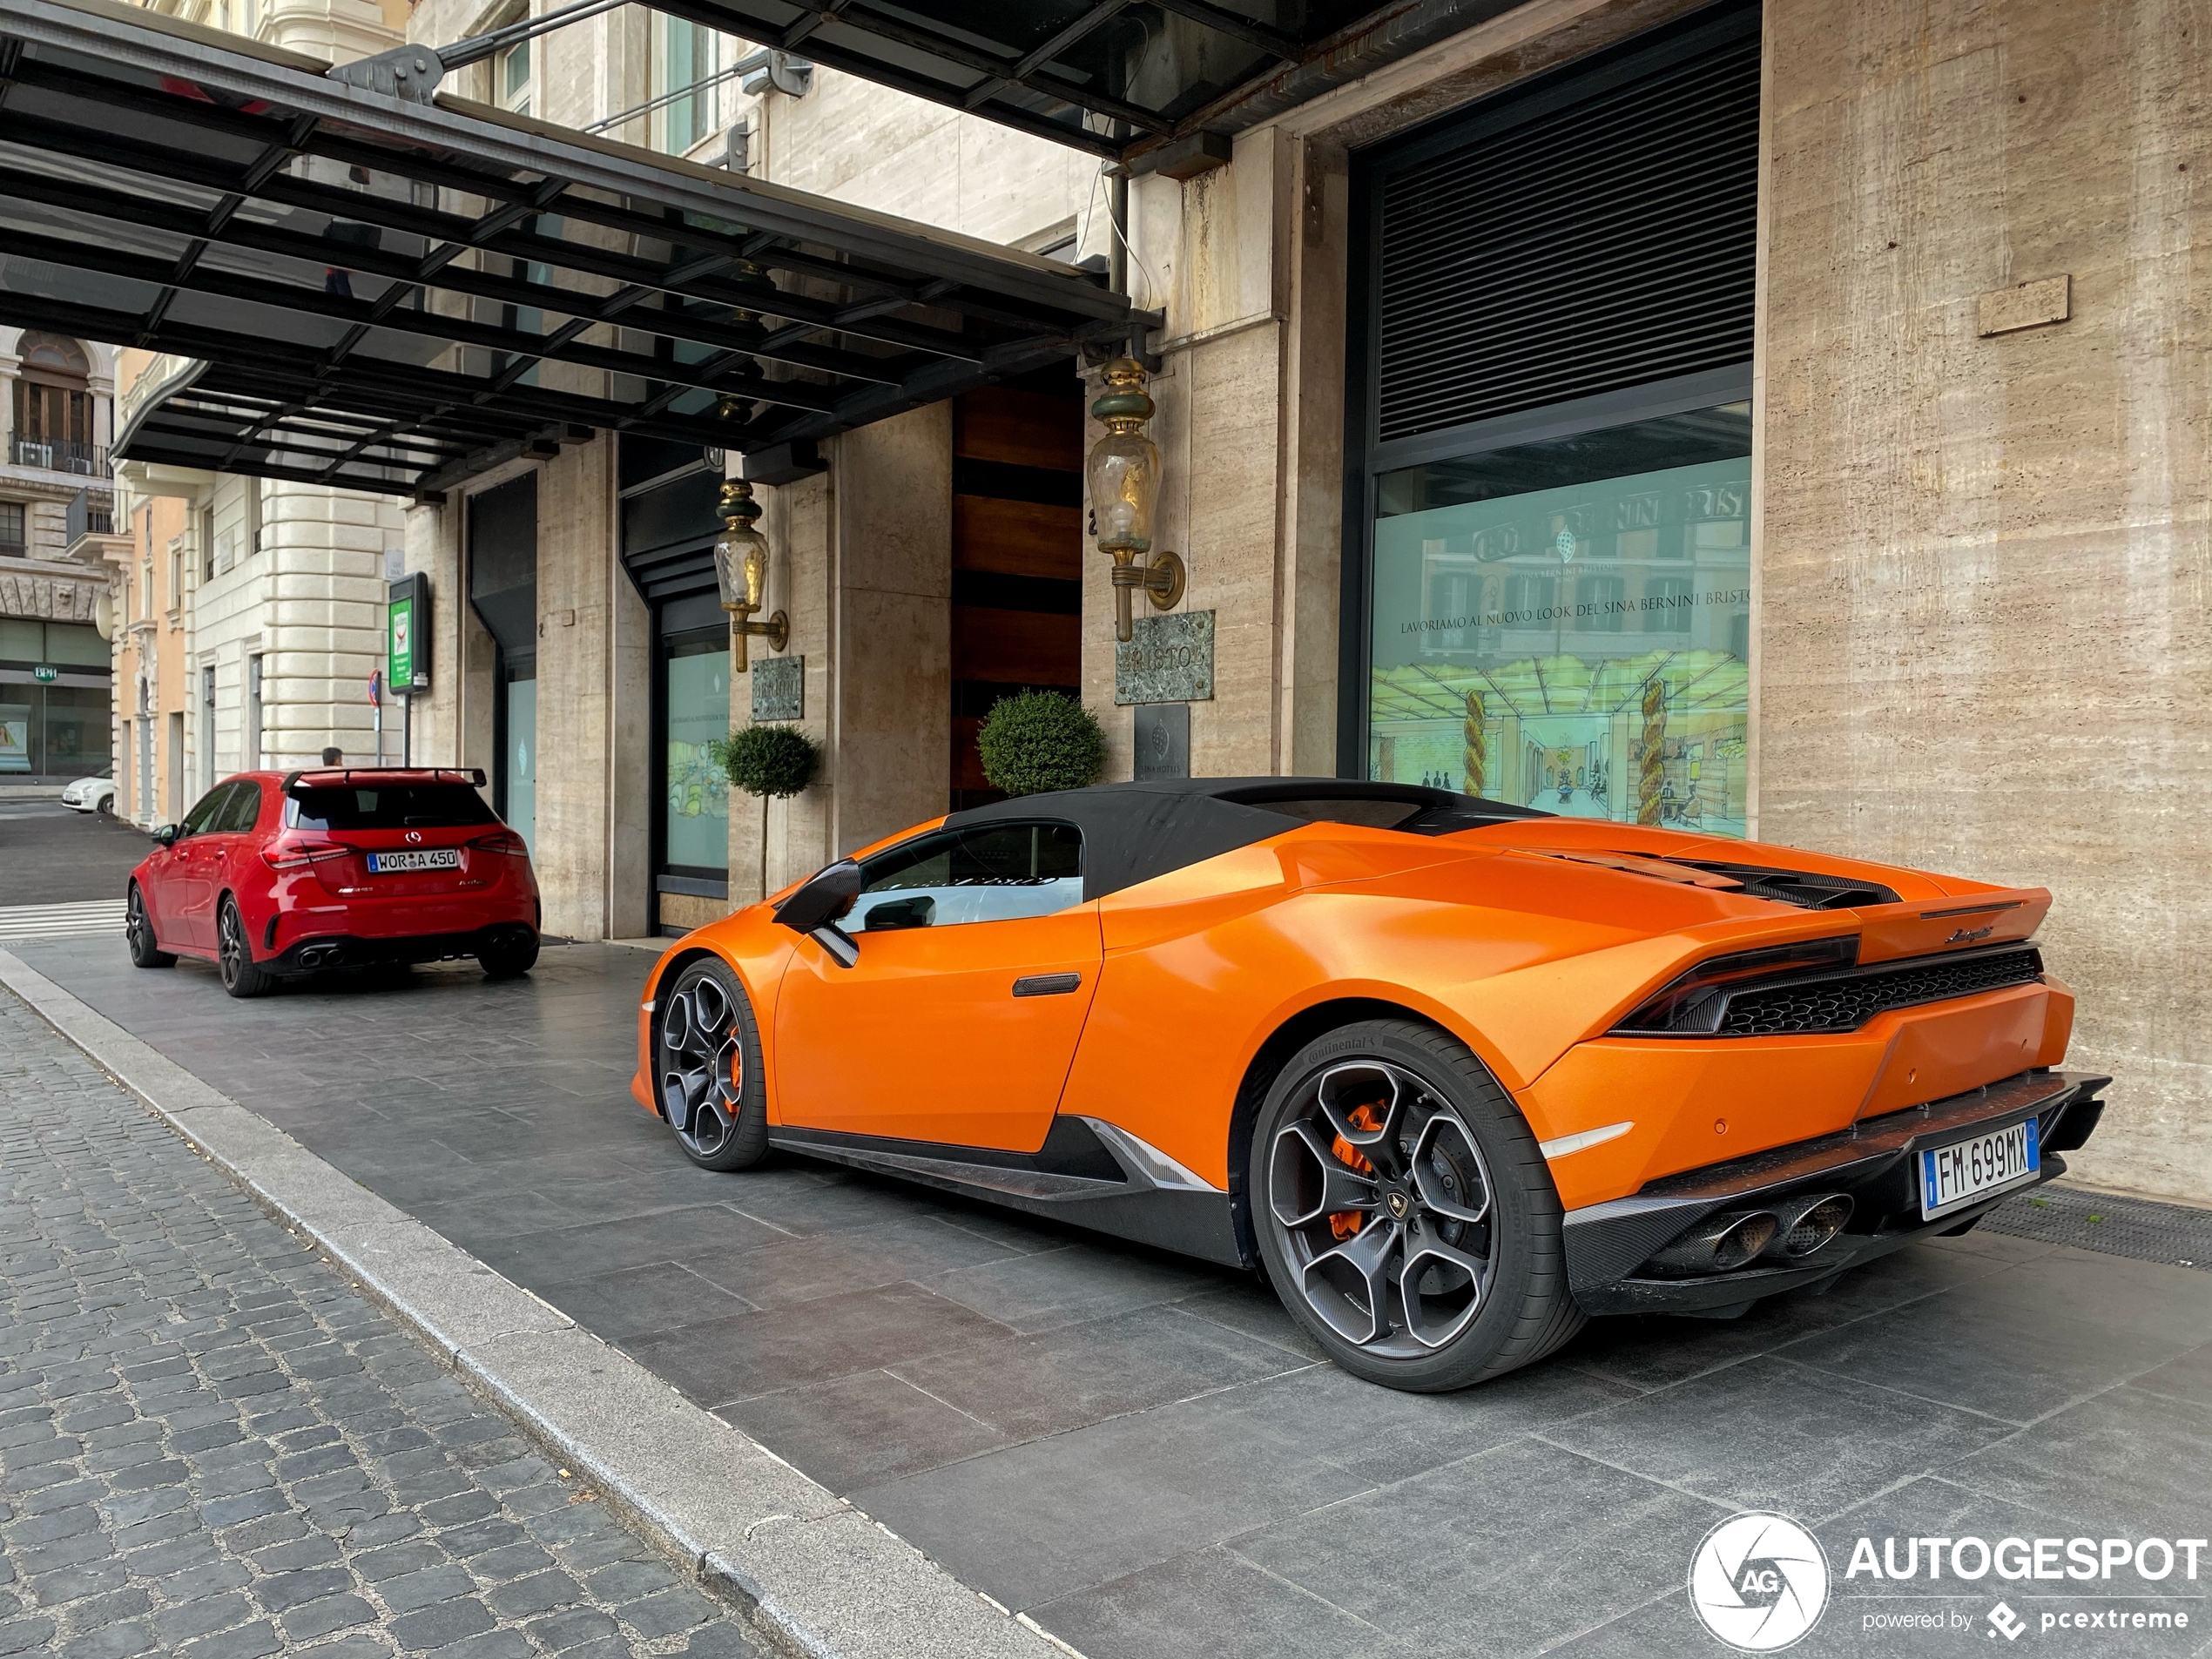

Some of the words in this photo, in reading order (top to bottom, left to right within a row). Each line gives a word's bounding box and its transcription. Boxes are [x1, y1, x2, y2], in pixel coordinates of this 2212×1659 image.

[1541, 567, 1576, 578] BERNINI
[1400, 617, 1467, 634] LAVORIAMO
[1468, 616, 1482, 627] AL
[1486, 610, 1533, 625] NUOVO
[1536, 605, 1572, 621] LOOK
[1576, 604, 1600, 617] DEL
[1603, 600, 1636, 614] SINA
[1640, 594, 1700, 611] BERNINI
[1118, 645, 1205, 672] BRISTOL
[1157, 765, 1181, 773] HOTELS
[378, 854, 408, 869] WOR
[417, 853, 427, 867] A
[429, 852, 455, 866] 450
[1308, 1036, 1366, 1065] Continental
[1939, 1147, 1966, 1199] FM
[1971, 1126, 2028, 1186] 699MX
